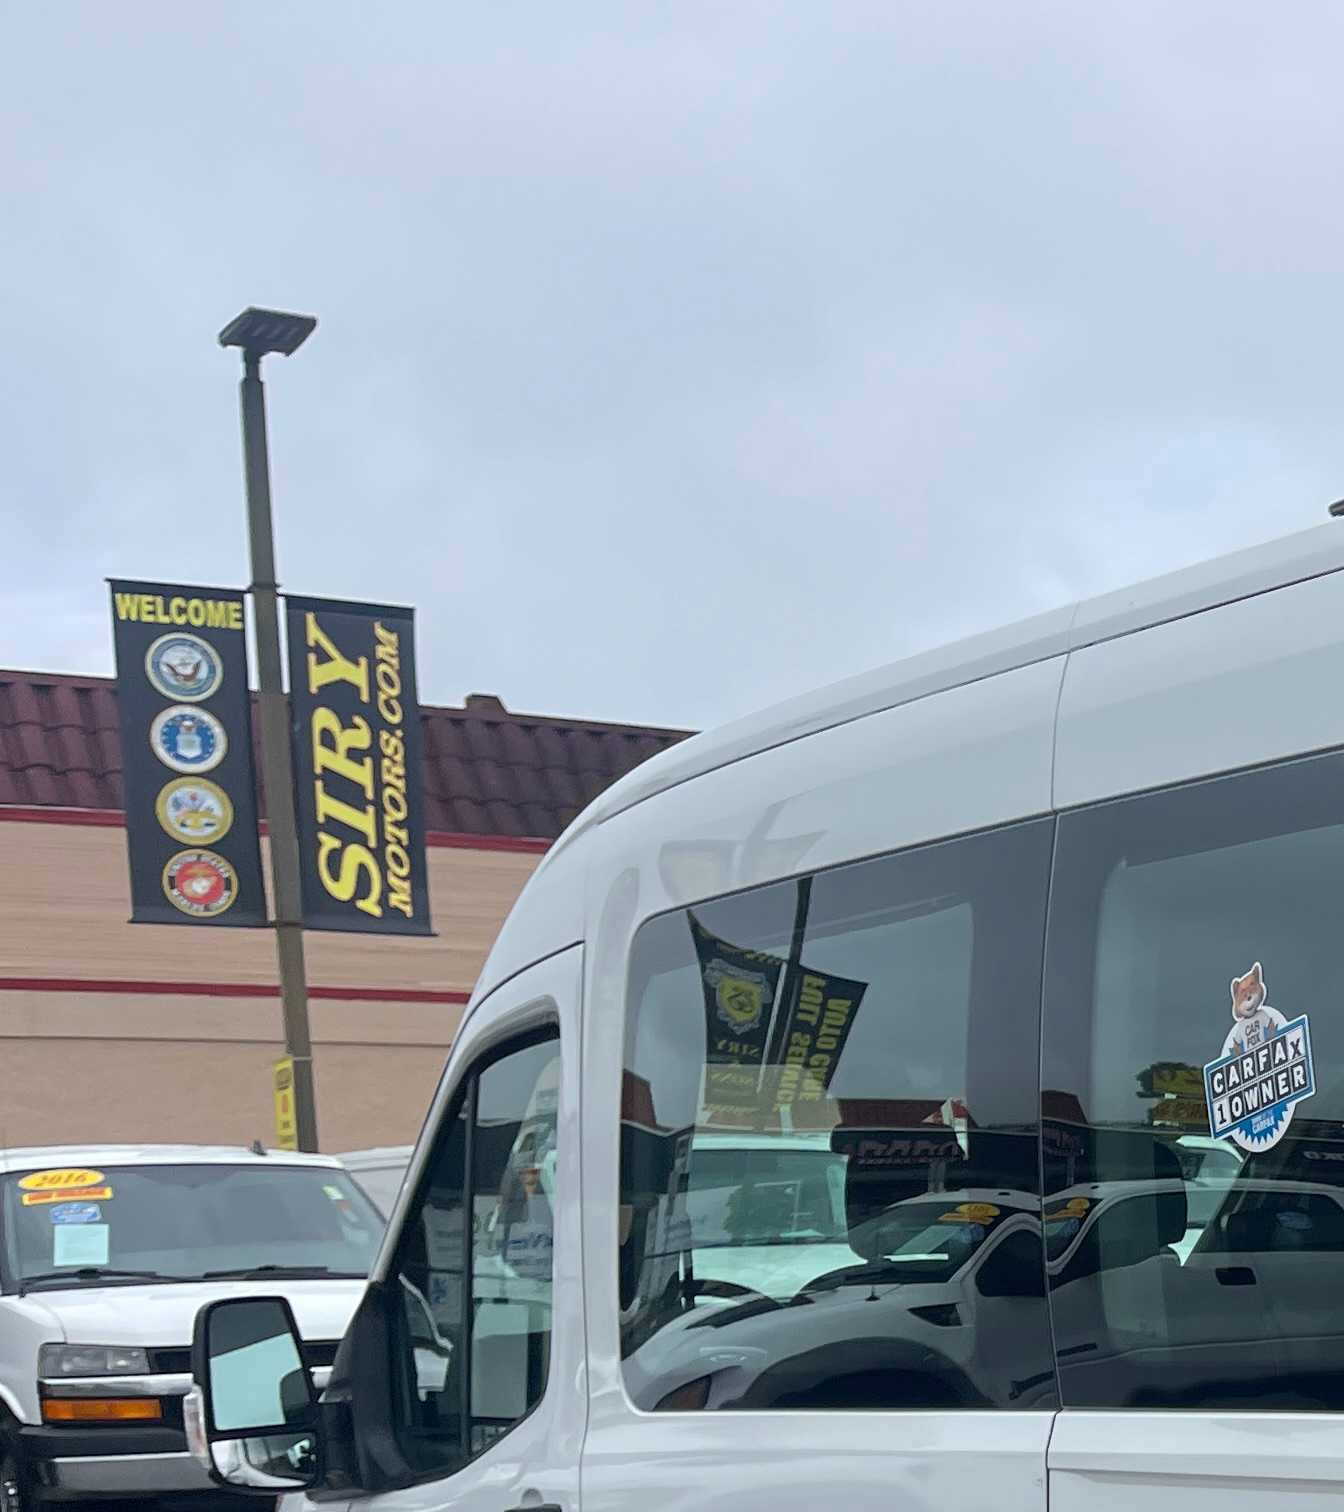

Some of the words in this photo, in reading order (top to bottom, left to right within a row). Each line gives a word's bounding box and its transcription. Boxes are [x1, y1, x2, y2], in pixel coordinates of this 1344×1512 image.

[115, 593, 244, 630] WELCOME
[305, 611, 383, 918] SIRY
[374, 621, 414, 918] MOTORS.COM
[1244, 1020, 1260, 1036] CAR
[1212, 1038, 1303, 1095] CARFAX
[35, 1172, 88, 1187] 2016
